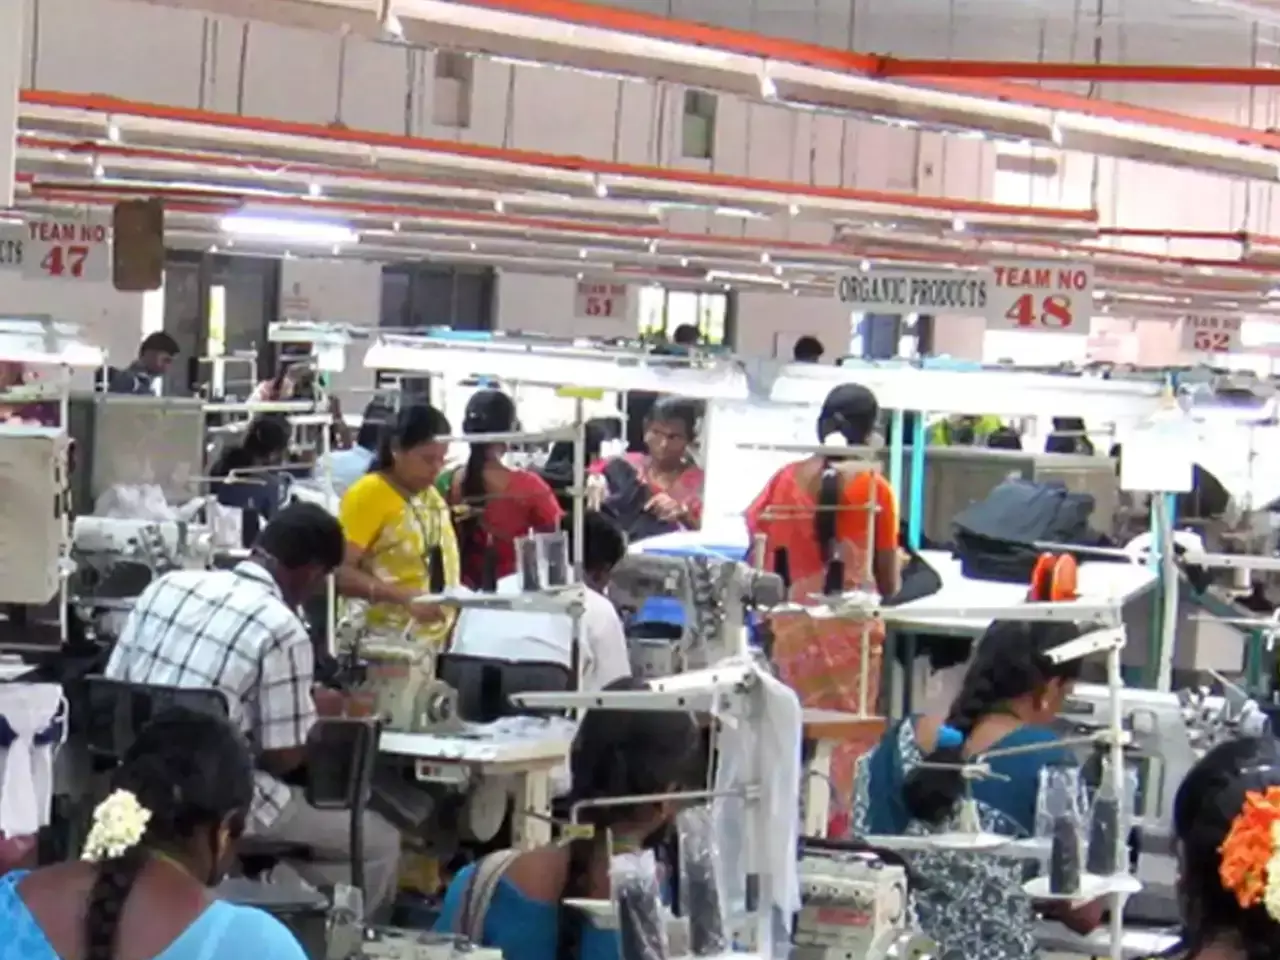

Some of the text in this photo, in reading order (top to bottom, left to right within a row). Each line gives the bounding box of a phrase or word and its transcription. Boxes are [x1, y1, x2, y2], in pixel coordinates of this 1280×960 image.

[28, 221, 75, 241] TEAM
[40, 245, 90, 277] 47
[838, 275, 988, 308] ORGANIC PRODUCTS
[994, 267, 1087, 290] TEAM NO
[1005, 293, 1073, 328] 48
[1193, 330, 1230, 351] 52
